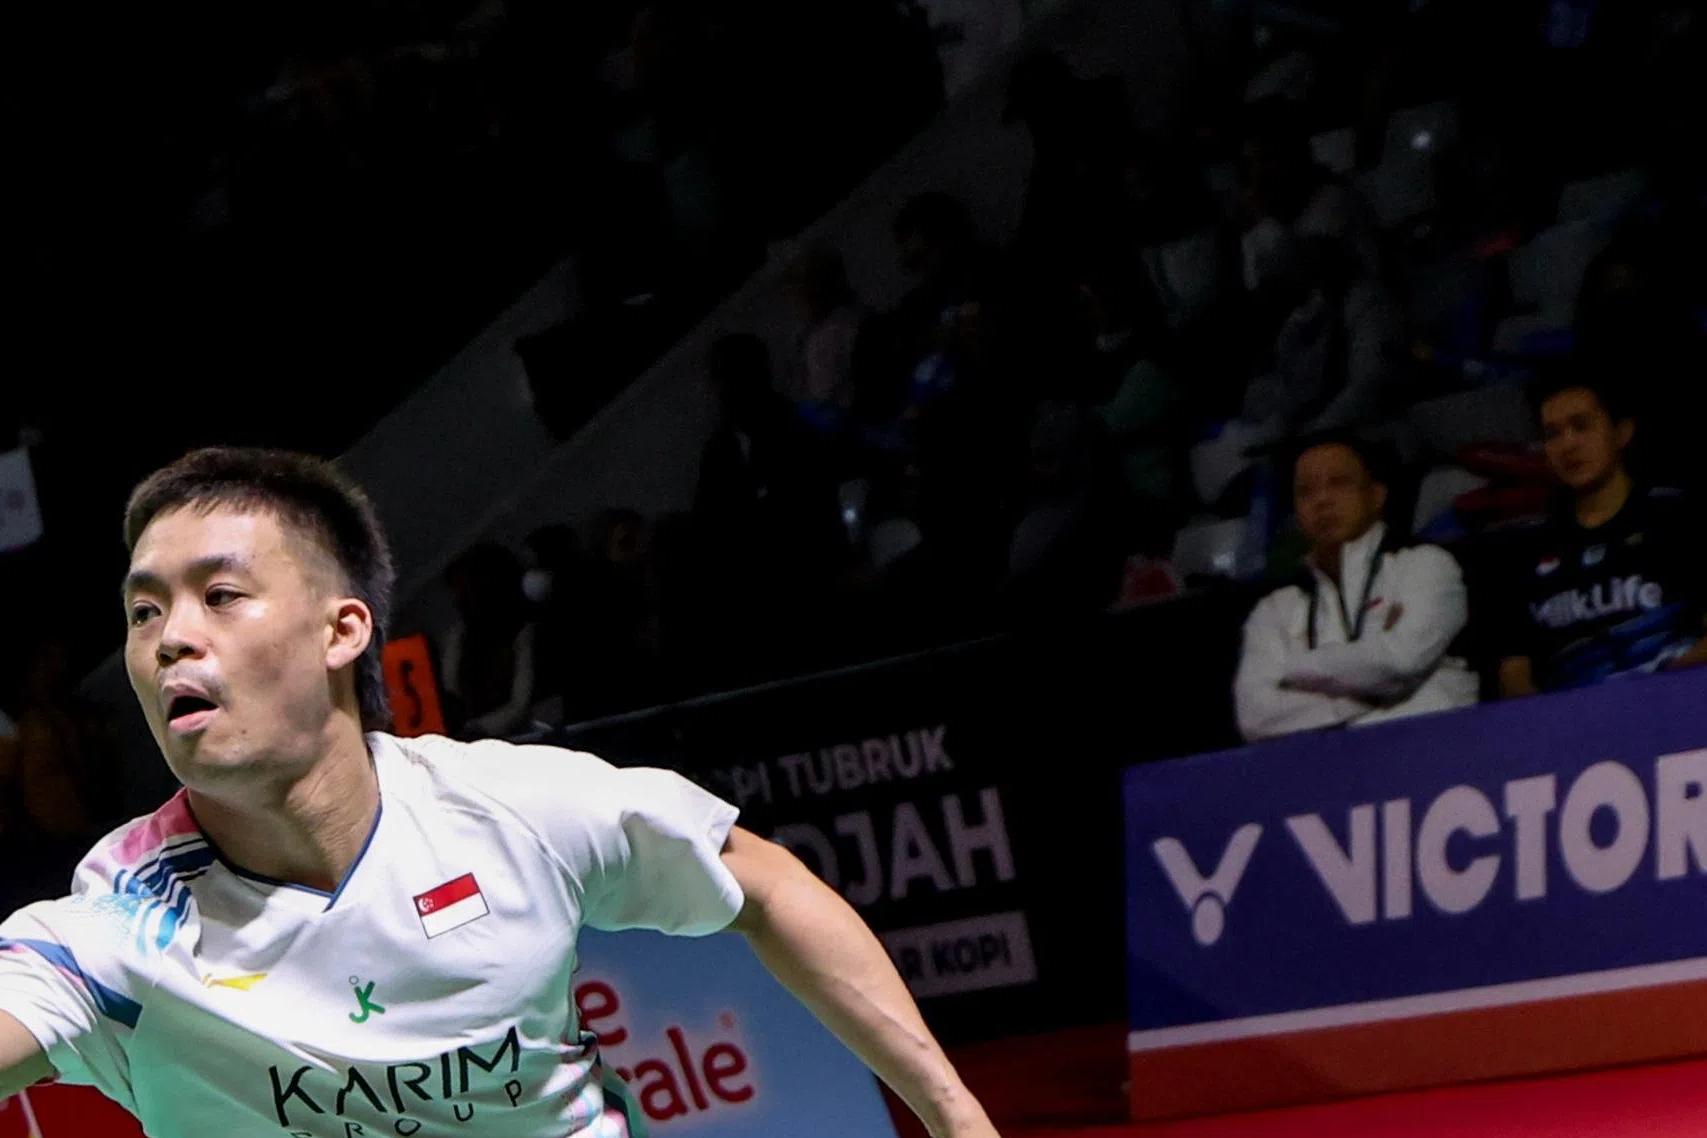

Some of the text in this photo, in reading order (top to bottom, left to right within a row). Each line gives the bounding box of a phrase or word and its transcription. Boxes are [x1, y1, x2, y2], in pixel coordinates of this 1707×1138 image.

[776, 722, 956, 800] TUBRUK
[770, 785, 1018, 906] DJAH
[1285, 746, 1707, 926] VICTOR
[574, 980, 629, 1046] e
[268, 1025, 521, 1128] KARIM
